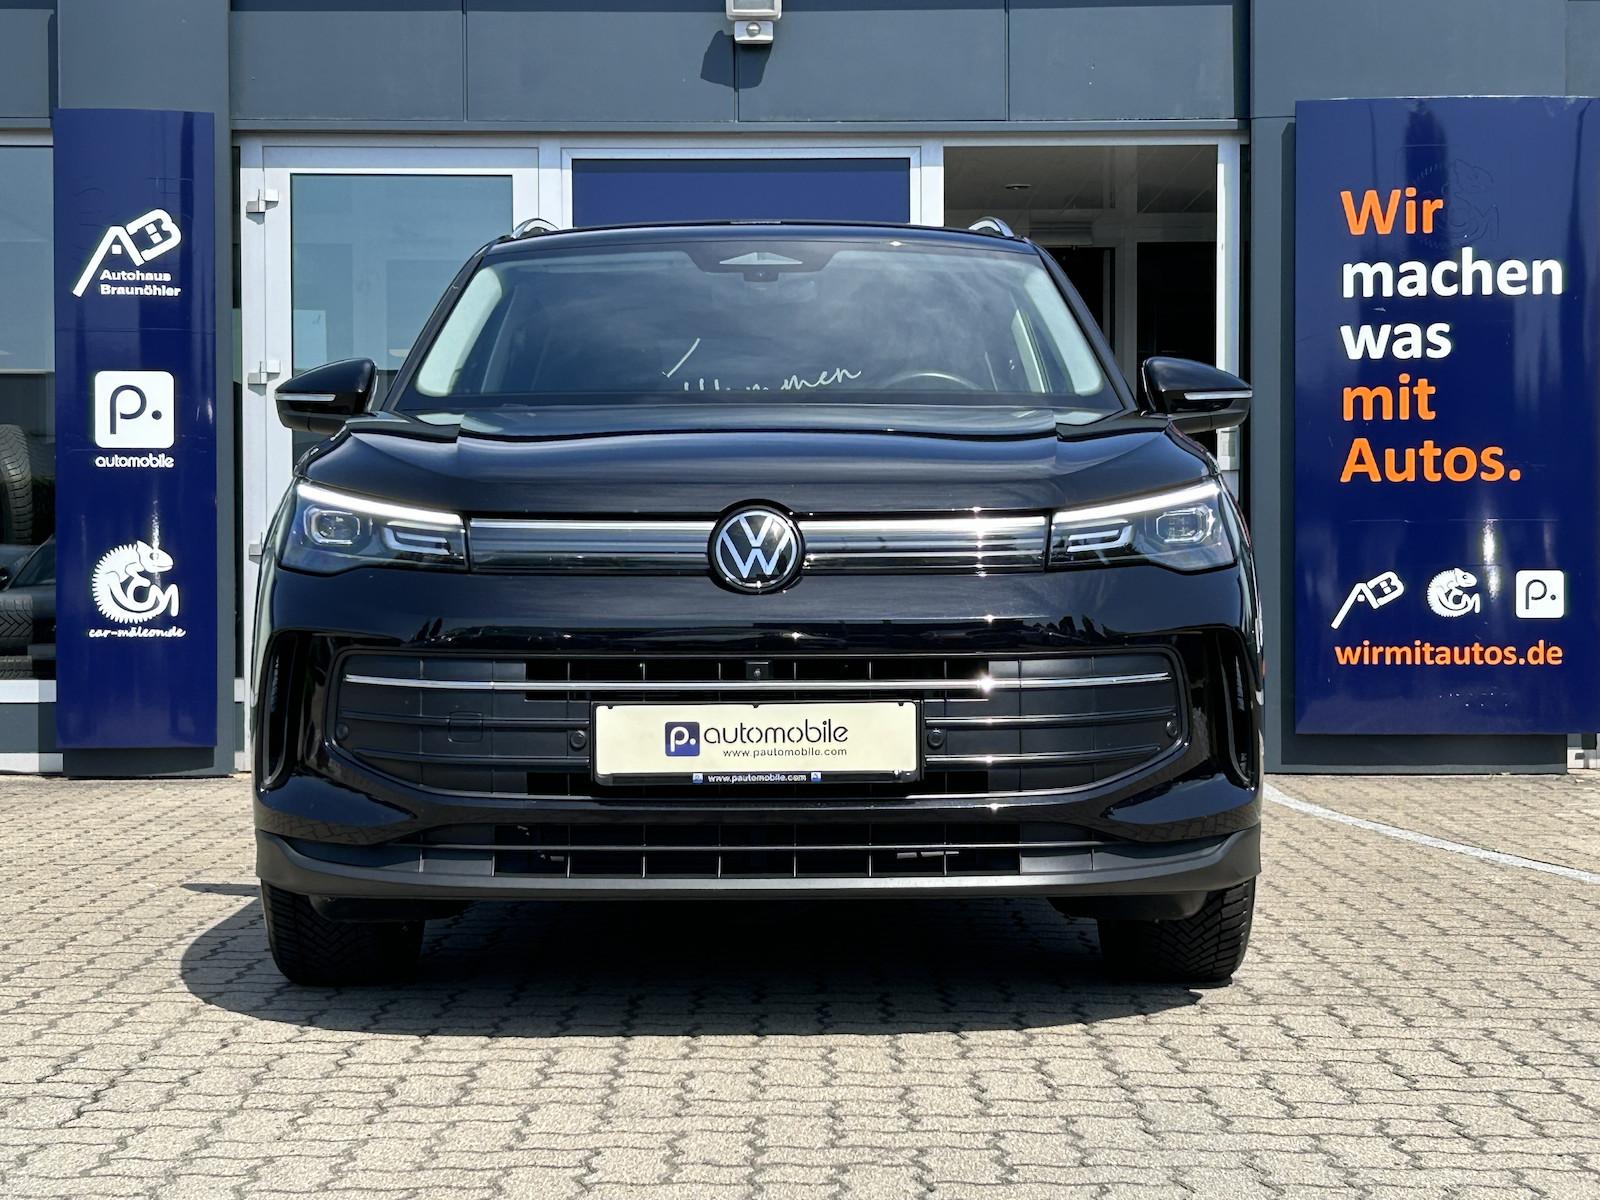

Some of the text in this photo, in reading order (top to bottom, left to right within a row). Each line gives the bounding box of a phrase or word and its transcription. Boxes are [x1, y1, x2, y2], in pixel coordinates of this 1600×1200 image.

[1340, 187, 1443, 235] Wir
[100, 270, 171, 282] Autohaus
[1342, 247, 1562, 298] machen
[100, 284, 181, 297] Braunöhler
[1340, 322, 1452, 360] was
[1343, 373, 1436, 421] mit
[95, 450, 175, 468] automobile
[1340, 438, 1521, 483] Autos.
[1334, 639, 1564, 666] wirmitautos.de
[703, 718, 848, 744] automobile
[723, 747, 848, 759] www.pautomobile.com
[707, 773, 807, 784] www.pautomobile.com
